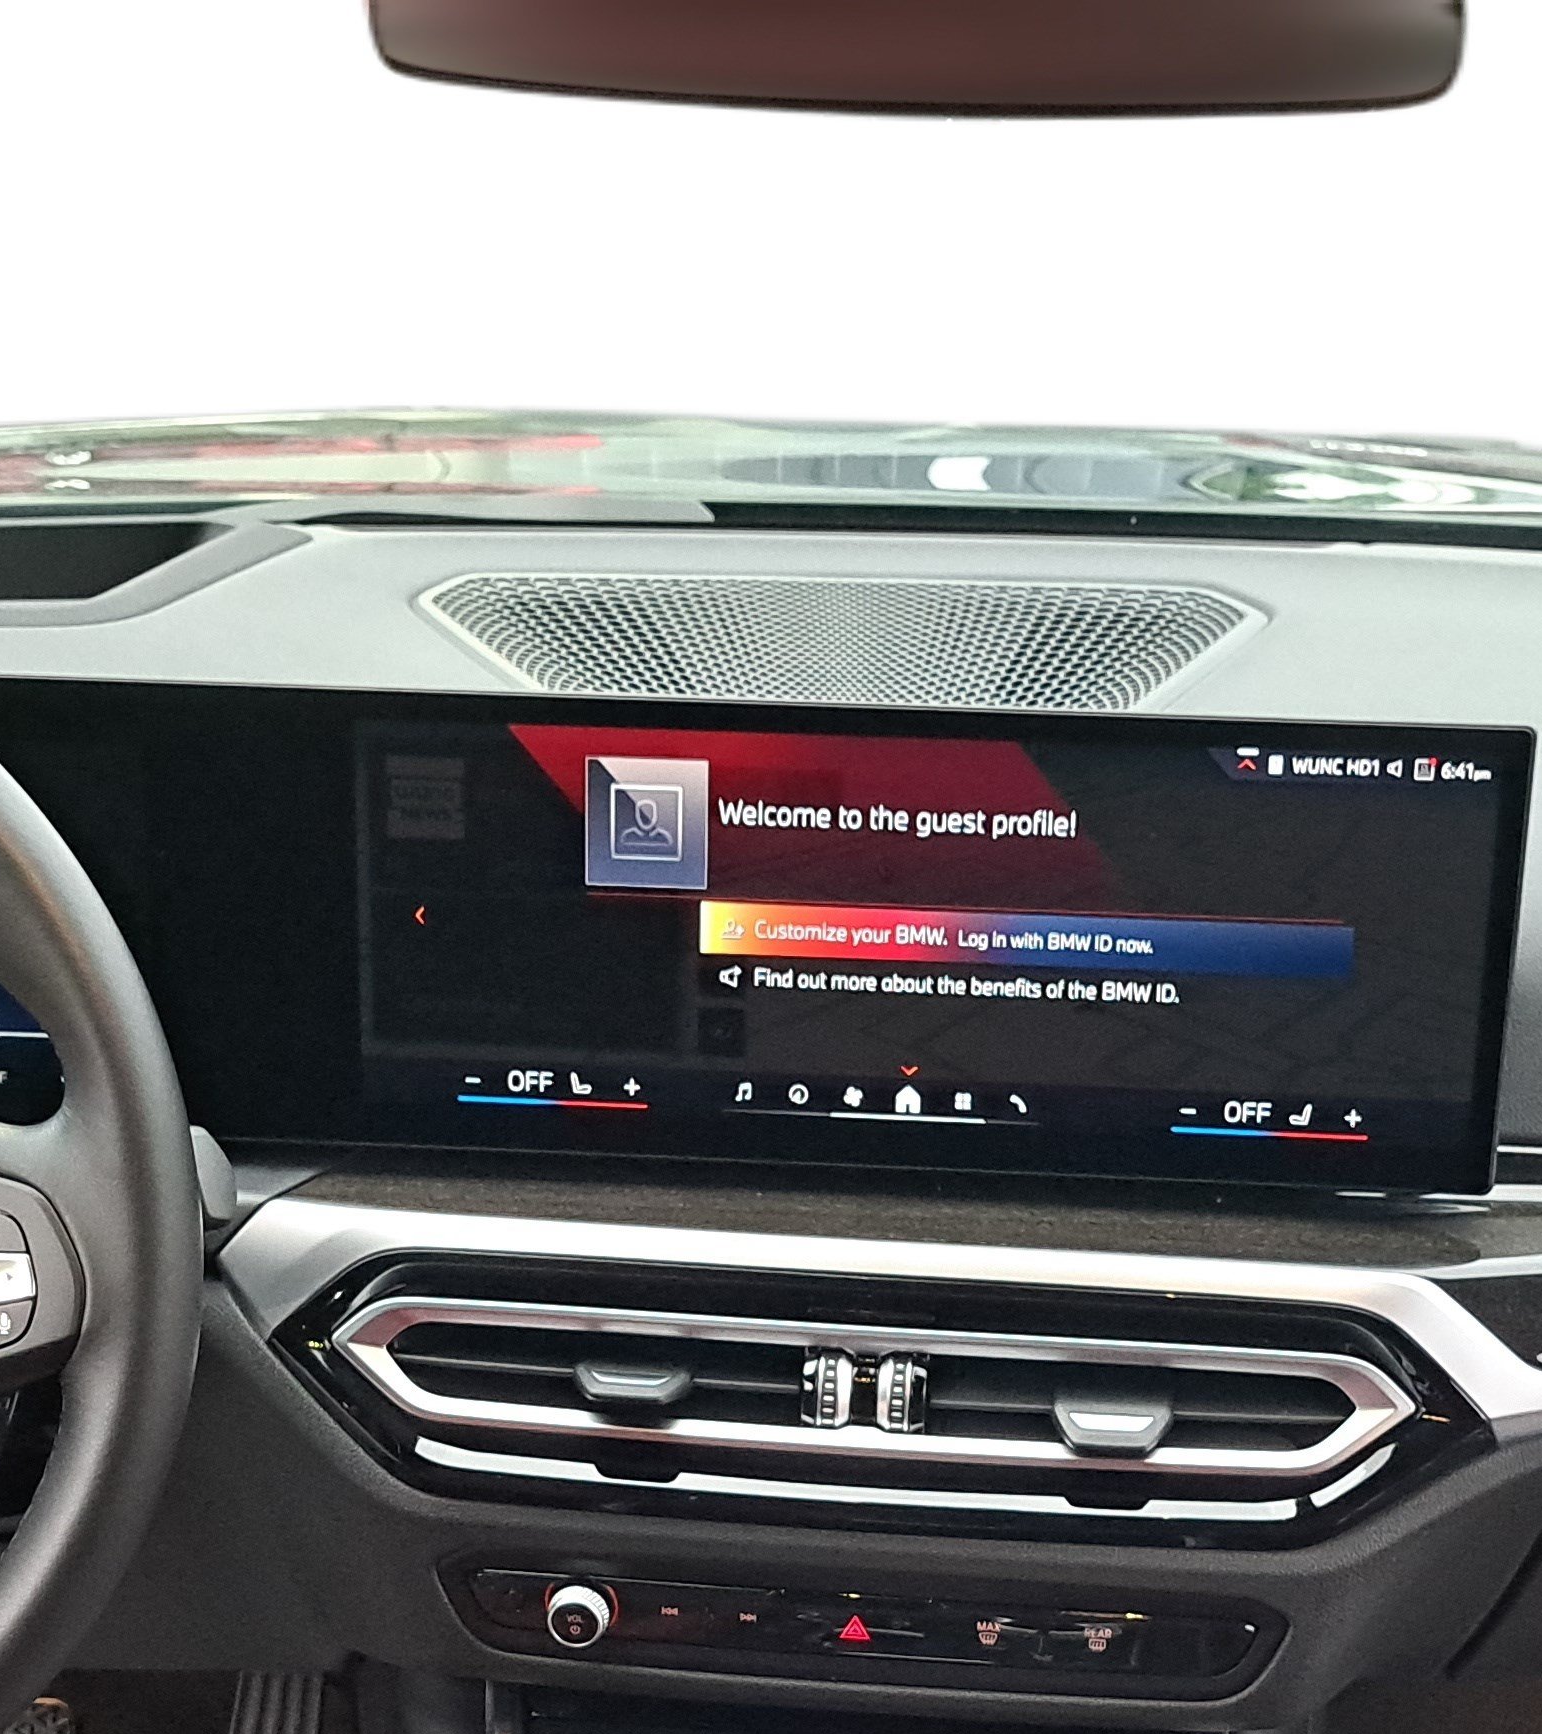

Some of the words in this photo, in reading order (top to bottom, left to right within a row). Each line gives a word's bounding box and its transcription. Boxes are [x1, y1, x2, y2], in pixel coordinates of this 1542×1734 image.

[1291, 756, 1344, 777] WUNC
[1346, 757, 1380, 777] HD1
[718, 797, 831, 829] Welcome
[838, 805, 863, 830] to
[869, 804, 909, 833] the
[916, 812, 986, 838] guest
[992, 809, 1078, 841] profile!
[754, 919, 848, 943] Customize
[851, 926, 892, 946] your
[895, 924, 948, 947] BMW.
[958, 929, 989, 951] Log
[992, 930, 1007, 948] in
[1010, 932, 1044, 950] with
[1047, 932, 1091, 951] BMW
[1094, 934, 1112, 952] ID
[1115, 940, 1154, 955] now.
[754, 968, 794, 989] Find
[797, 972, 828, 991] out
[831, 975, 877, 993] more
[881, 973, 934, 995] about
[937, 974, 967, 996] the
[970, 976, 1042, 1000] benefits
[1046, 979, 1066, 999] of
[1068, 980, 1097, 1001] the
[1101, 980, 1152, 1003] BMW
[1156, 983, 1180, 1004] ID.
[507, 1069, 555, 1093] OFF
[1224, 1100, 1272, 1123] OFF
[977, 1621, 1001, 1632] MAX
